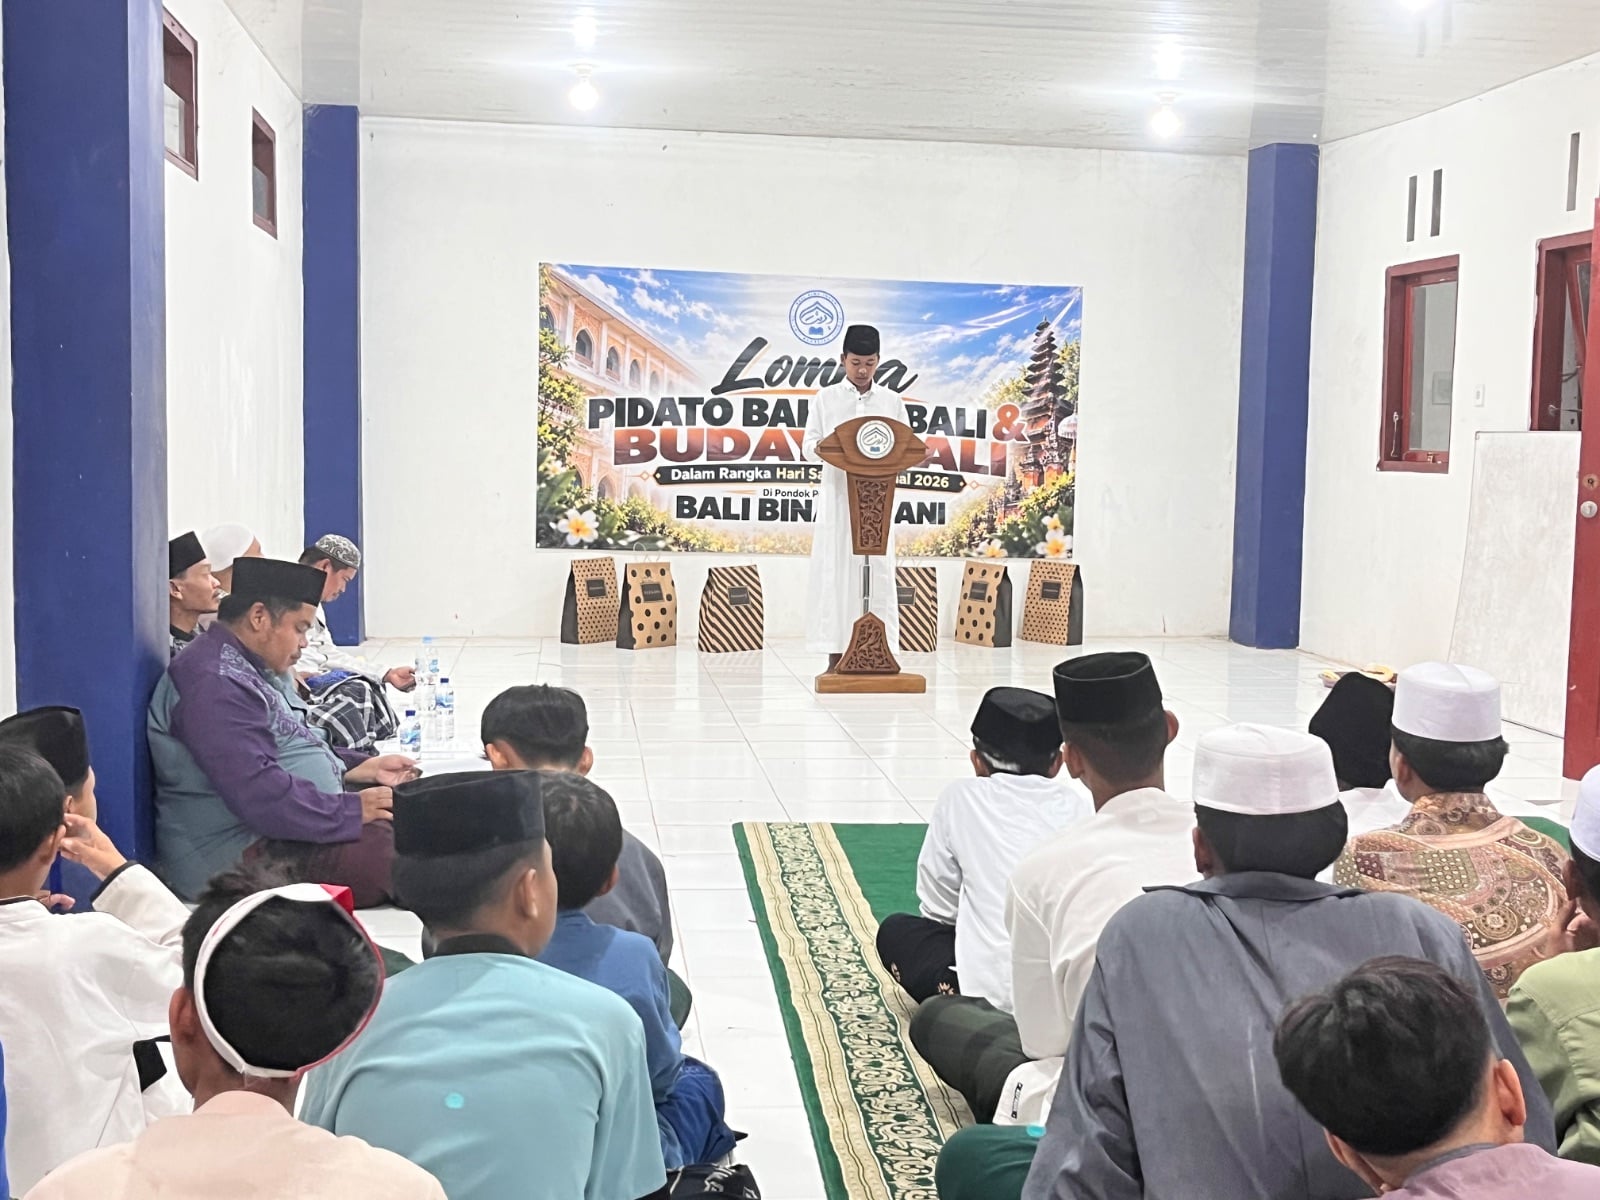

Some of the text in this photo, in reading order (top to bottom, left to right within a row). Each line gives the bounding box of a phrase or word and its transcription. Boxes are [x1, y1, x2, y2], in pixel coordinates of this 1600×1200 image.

[711, 337, 918, 395] Loma
[588, 396, 734, 429] PIDATO
[904, 404, 988, 439] BALI
[992, 403, 1030, 442] &
[913, 436, 1007, 478] ALI
[671, 467, 716, 481] Dalam
[719, 466, 772, 482] Rangka
[776, 466, 806, 480] Hari
[914, 473, 950, 489] 2026
[763, 488, 773, 497] Di
[774, 489, 811, 498] Pondok
[676, 495, 946, 525] BALI BIN ANI
